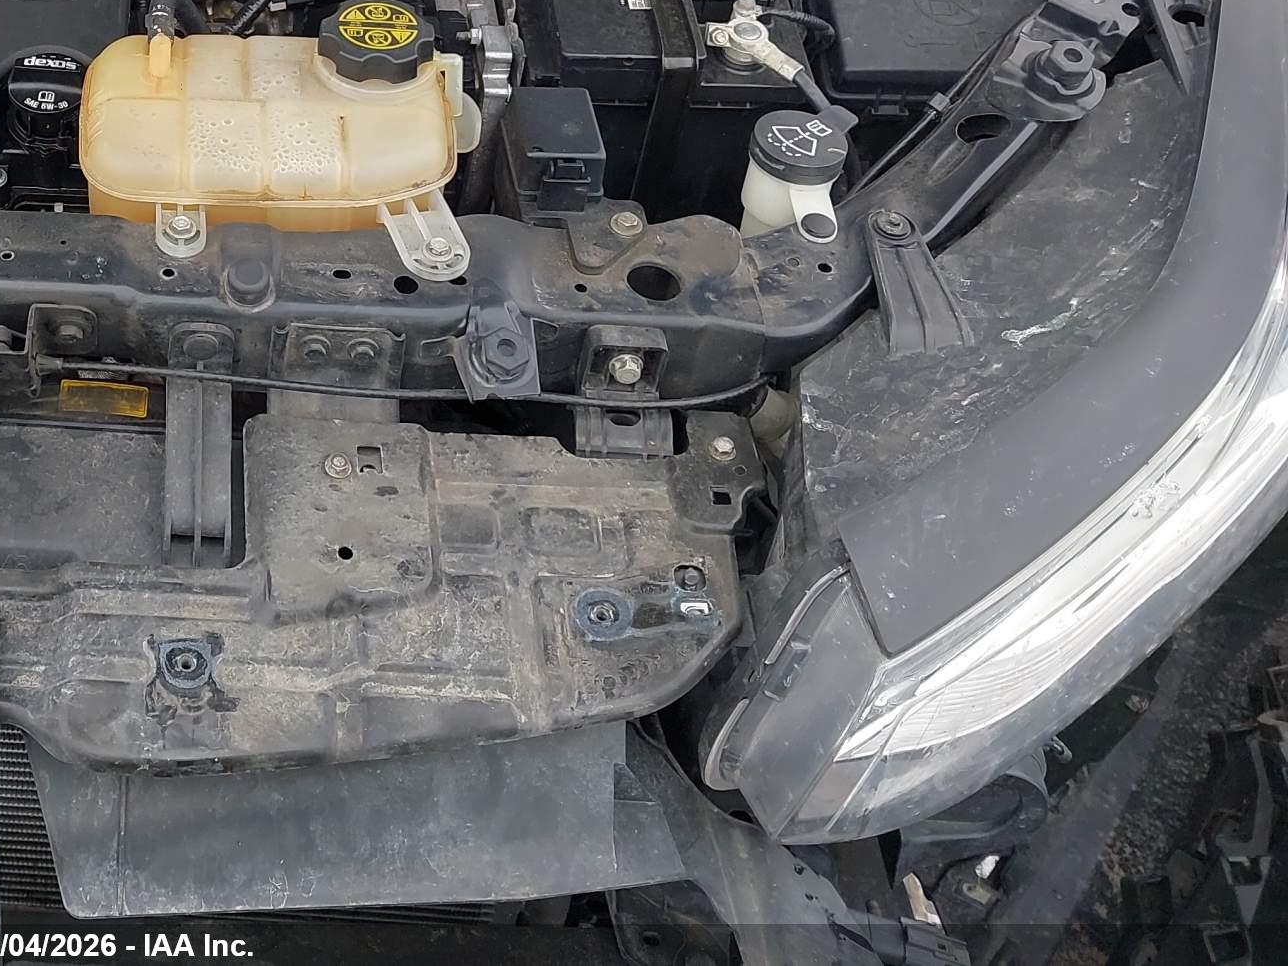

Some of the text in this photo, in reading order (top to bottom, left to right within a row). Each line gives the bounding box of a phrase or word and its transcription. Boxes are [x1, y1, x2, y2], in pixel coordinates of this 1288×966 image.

[23, 56, 77, 70] dexos
[23, 97, 69, 111] SAE 5W-30
